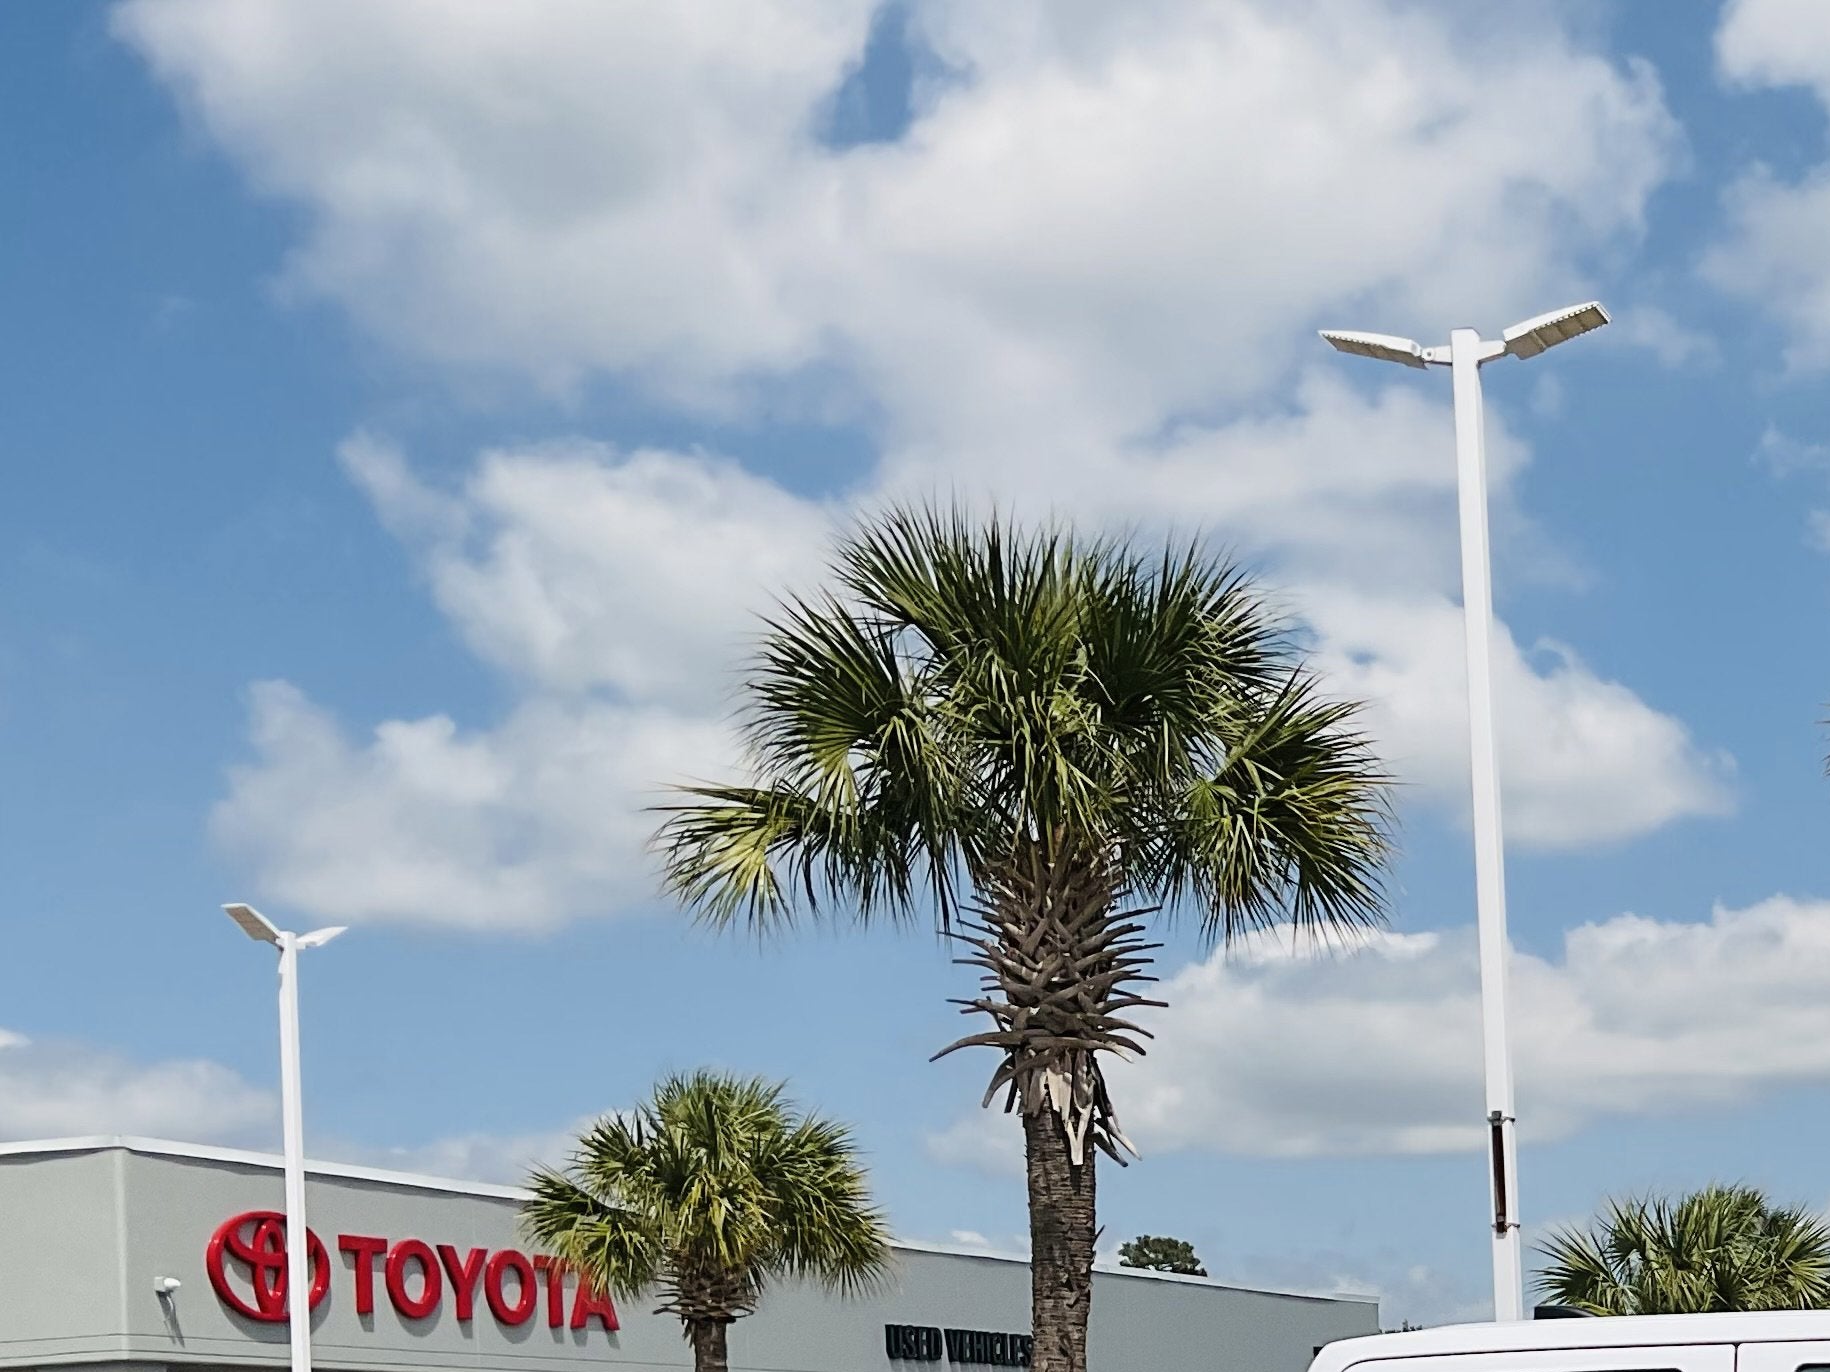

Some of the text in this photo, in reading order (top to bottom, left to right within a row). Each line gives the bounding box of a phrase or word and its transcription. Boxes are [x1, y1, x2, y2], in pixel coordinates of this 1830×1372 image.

[338, 1234, 620, 1331] TOYOTA
[885, 1324, 1033, 1367] USED VEHICLES
